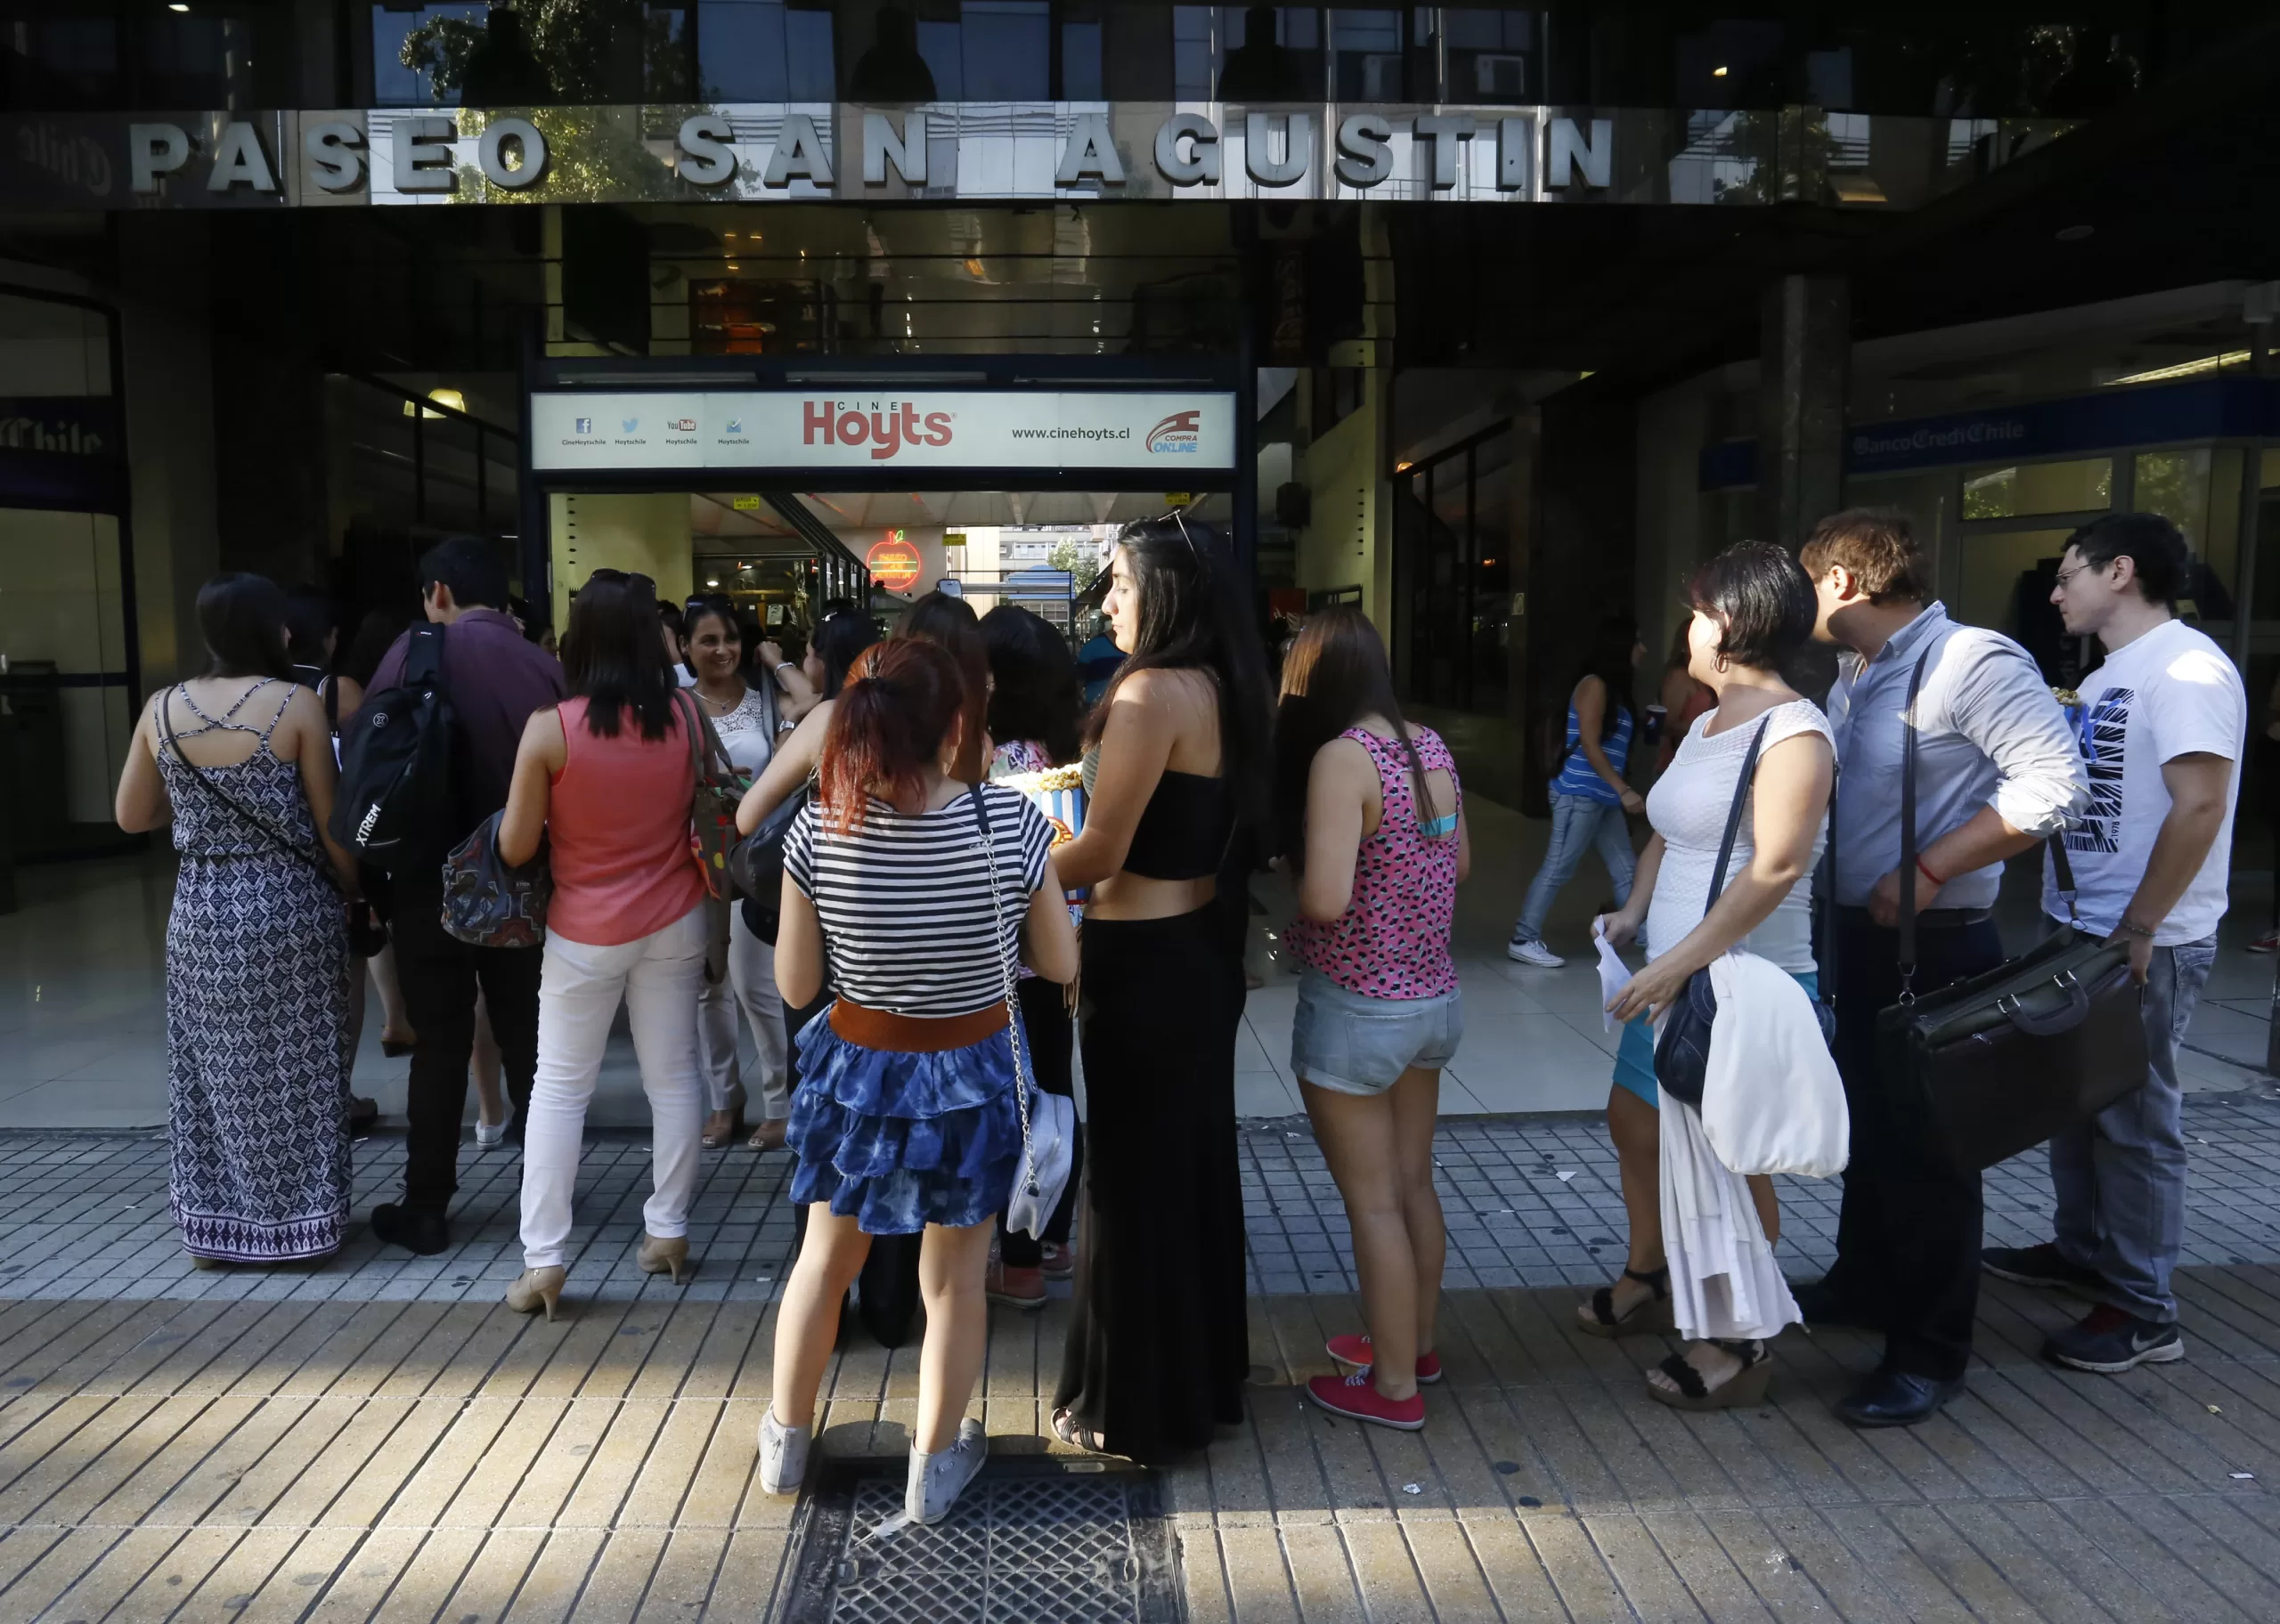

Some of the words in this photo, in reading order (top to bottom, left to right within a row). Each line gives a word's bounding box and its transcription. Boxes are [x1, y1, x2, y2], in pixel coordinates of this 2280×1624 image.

[129, 118, 549, 193] PASEO
[679, 113, 929, 189] SAN
[1054, 112, 1613, 192] AGUSTIN
[837, 402, 898, 410] CINE
[803, 401, 953, 459] Hoyts
[1012, 427, 1130, 442] www.cinehoyts.cl
[665, 438, 697, 446] Hoytschile
[718, 438, 750, 446] Hoytschile
[356, 803, 381, 847] XTREM
[2111, 820, 2121, 839] 1978
